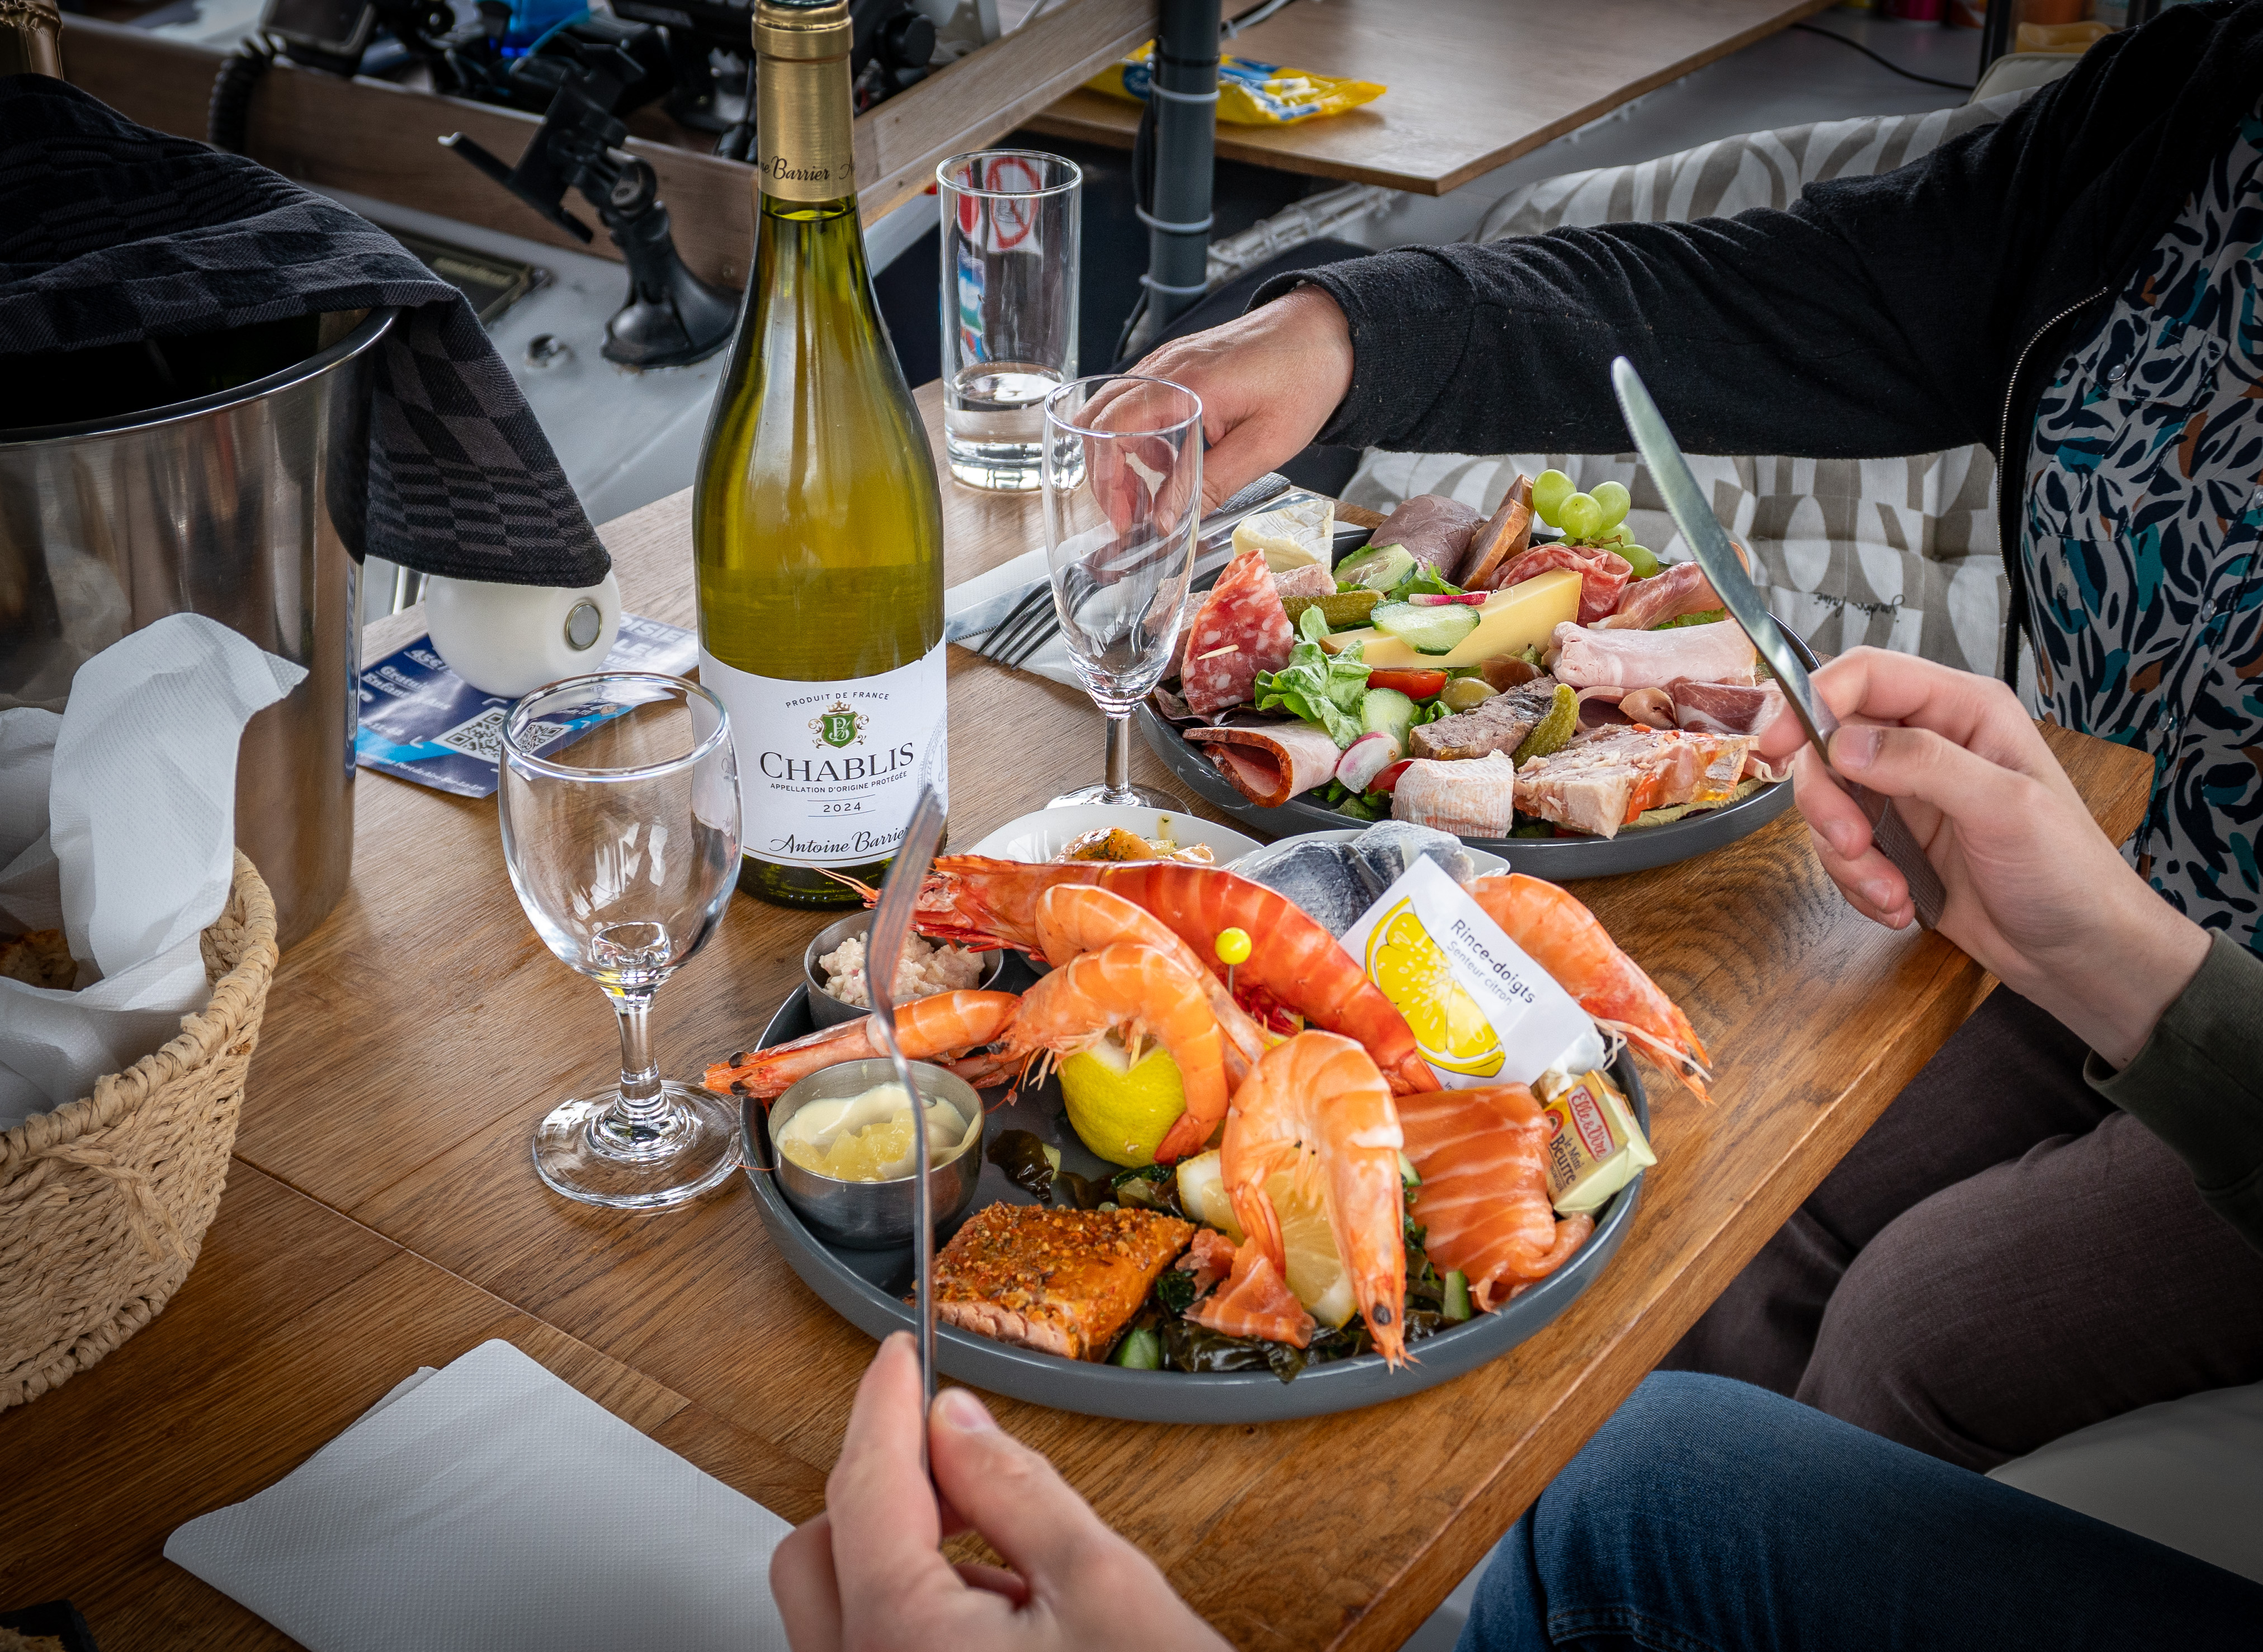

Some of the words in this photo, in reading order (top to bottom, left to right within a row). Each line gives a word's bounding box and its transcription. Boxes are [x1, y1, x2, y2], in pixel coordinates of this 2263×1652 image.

[771, 155, 830, 181] Barrier
[785, 693, 830, 709] PRODUIT
[853, 691, 890, 700] FRANCE
[759, 742, 914, 782] CHABLIS
[770, 782, 825, 793] APPELLATION
[828, 782, 869, 793] D'ORIGINE
[871, 771, 907, 787] PROTÉGÉE
[823, 801, 861, 813] 2024
[769, 834, 851, 854] Antoine
[1446, 940, 1486, 978] Senteur
[1484, 978, 1513, 1006] citron
[1450, 919, 1536, 1003] Rince-doigts
[1572, 1092, 1593, 1123] Elle
[1588, 1125, 1607, 1158] Vire
[1549, 1132, 1576, 1185] Beurre
[1567, 1146, 1585, 1170] Mini
